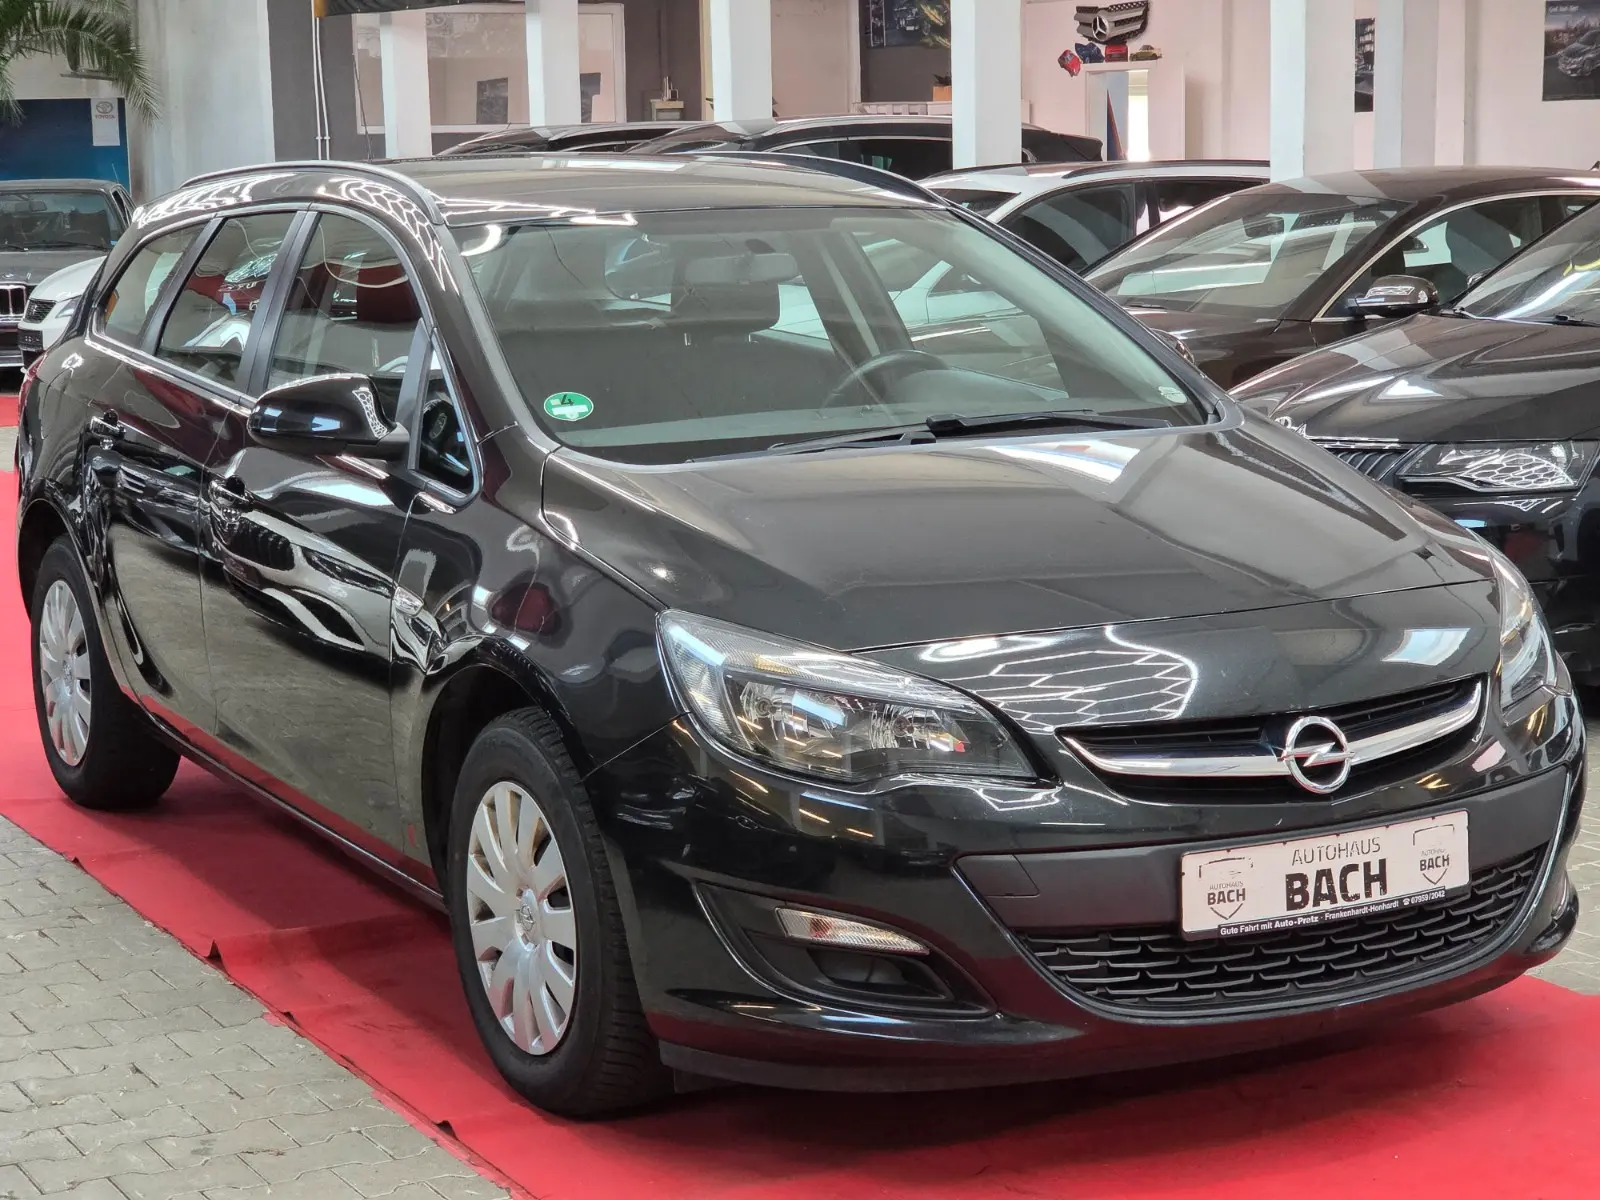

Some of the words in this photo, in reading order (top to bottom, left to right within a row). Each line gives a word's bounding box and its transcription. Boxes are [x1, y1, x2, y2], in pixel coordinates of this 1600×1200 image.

[560, 393, 575, 406] 4
[1292, 837, 1381, 866] AUTOHAUS
[1419, 853, 1450, 872] BACH
[1285, 858, 1388, 911] BACH
[1207, 887, 1246, 906] BACH
[1220, 927, 1239, 936] Gute
[1240, 924, 1260, 933] Fahrt
[1260, 921, 1273, 930] mit
